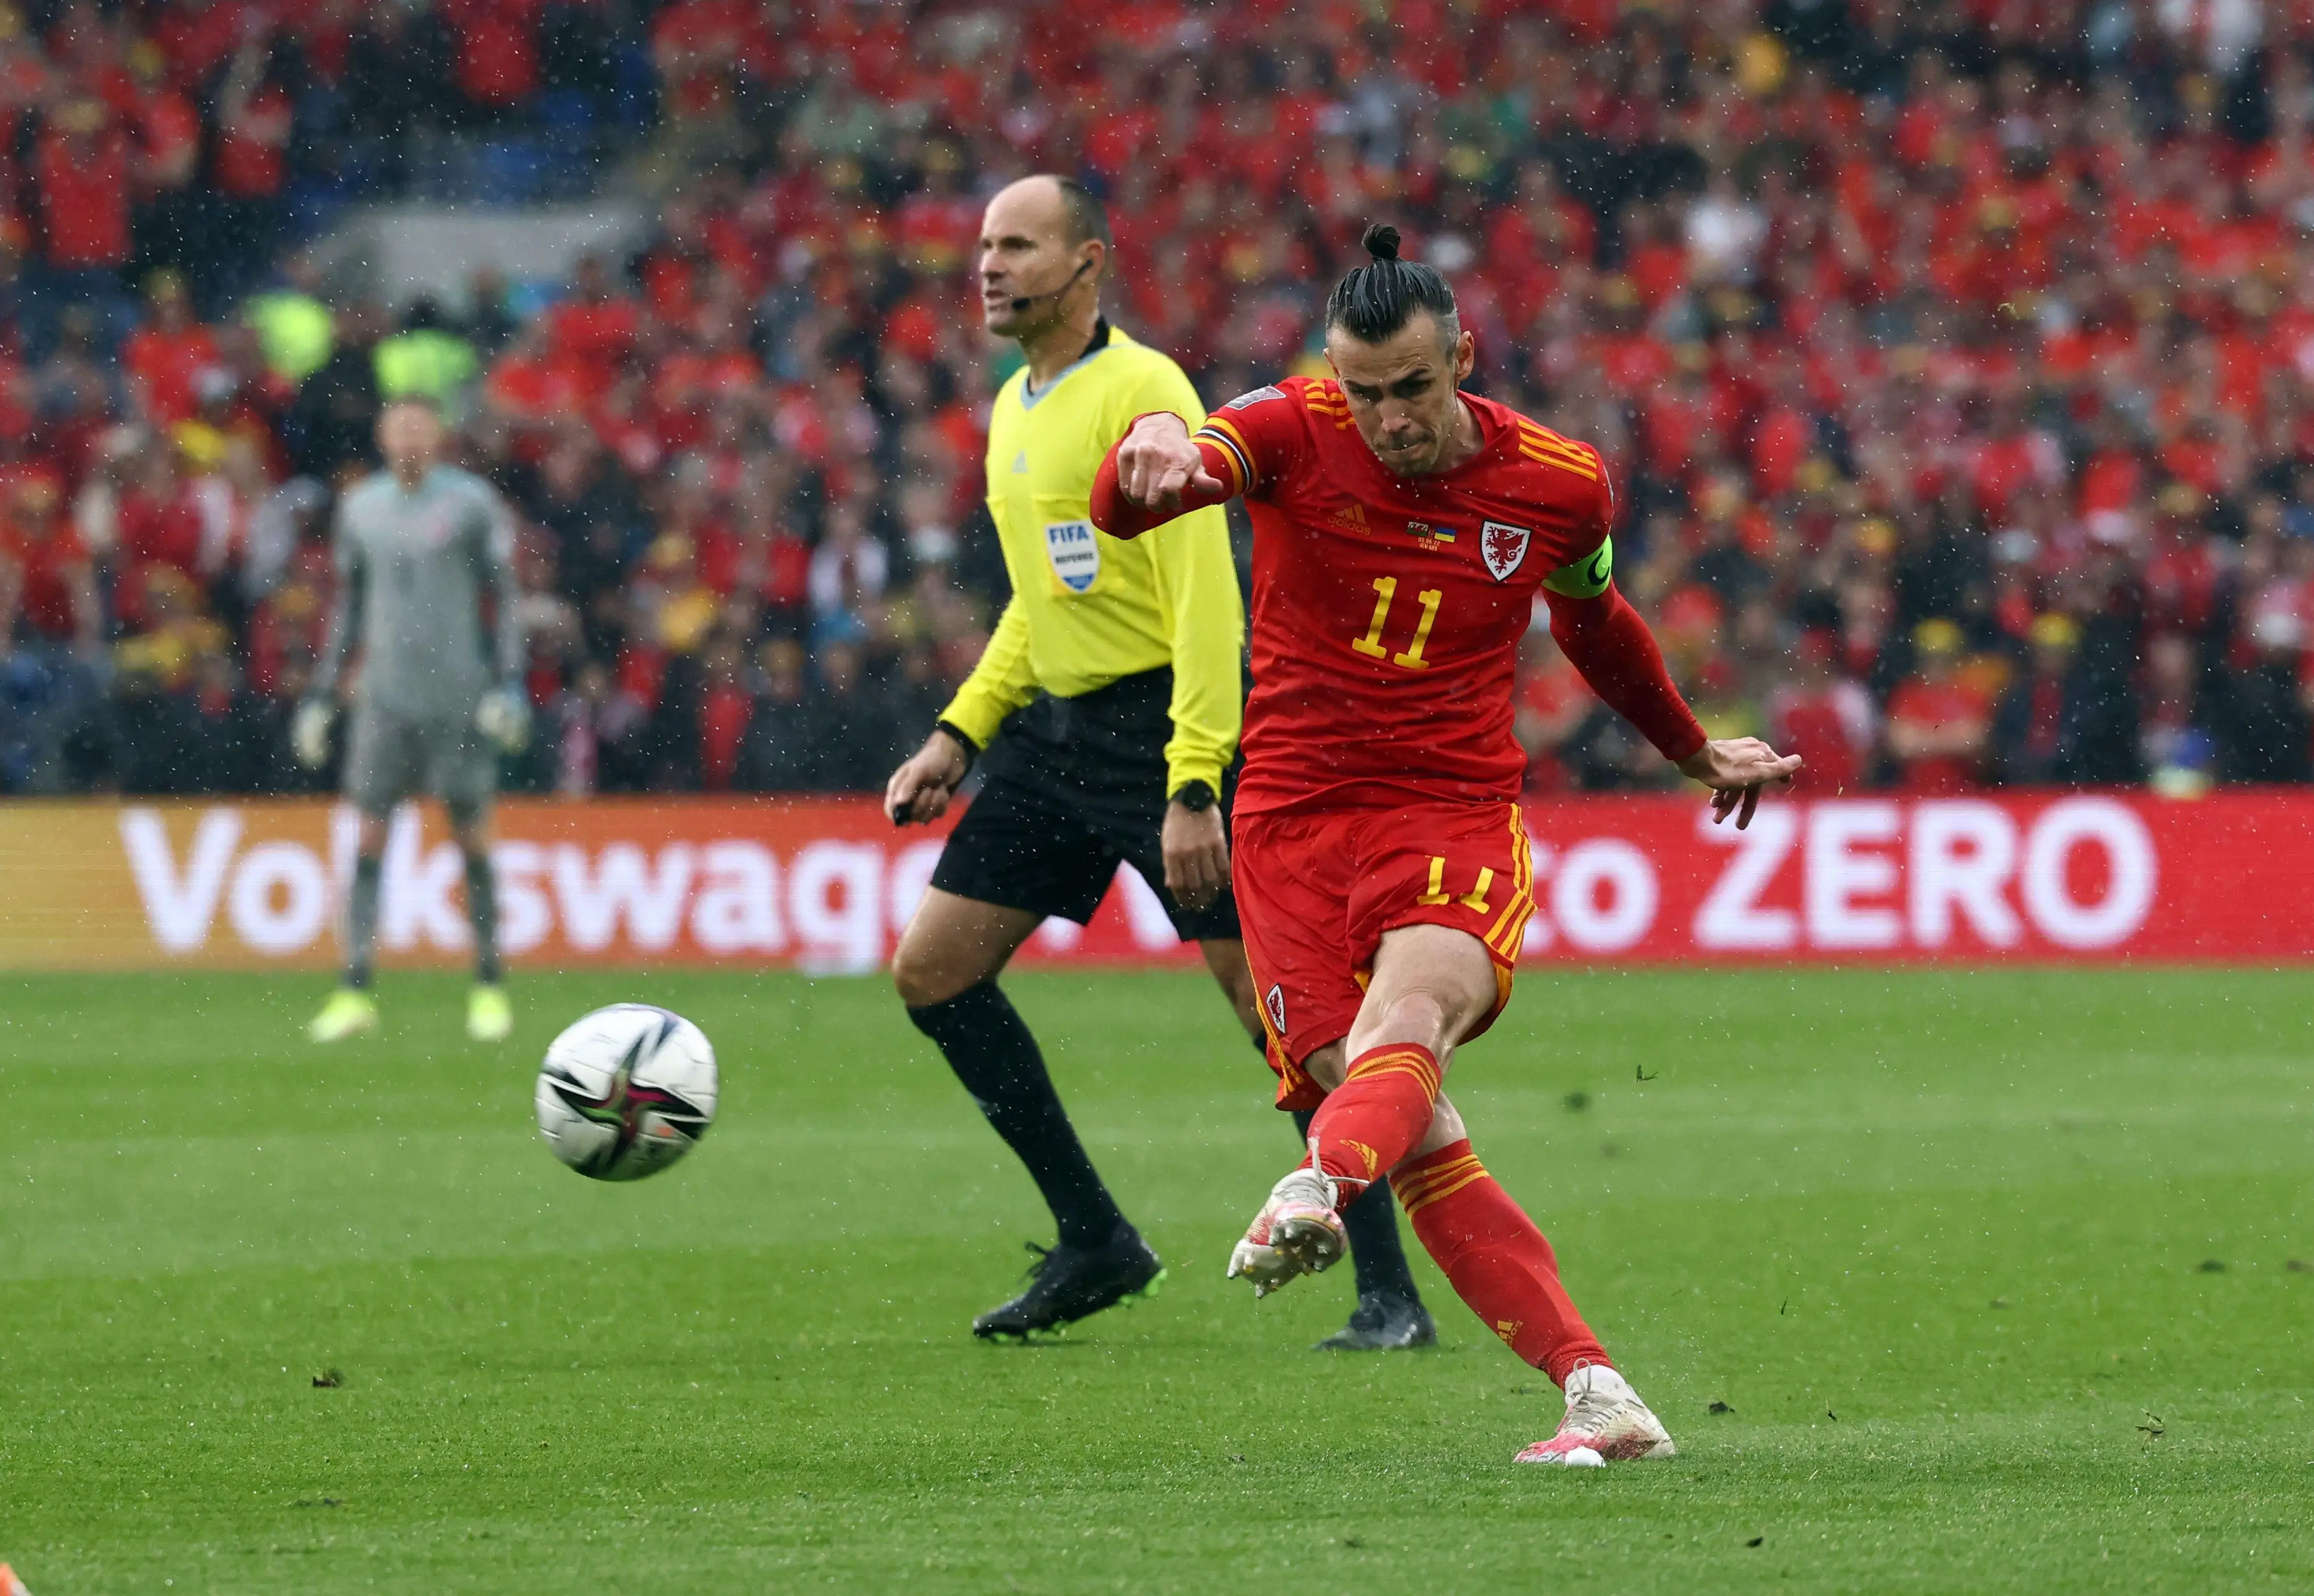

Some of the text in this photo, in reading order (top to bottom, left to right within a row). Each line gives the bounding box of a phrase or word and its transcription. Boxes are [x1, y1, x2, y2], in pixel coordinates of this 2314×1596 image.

[1049, 524, 1090, 544] FIFA
[1352, 576, 1443, 670] 11
[119, 804, 1084, 975] Volkswag
[1692, 794, 2160, 953] ZERO
